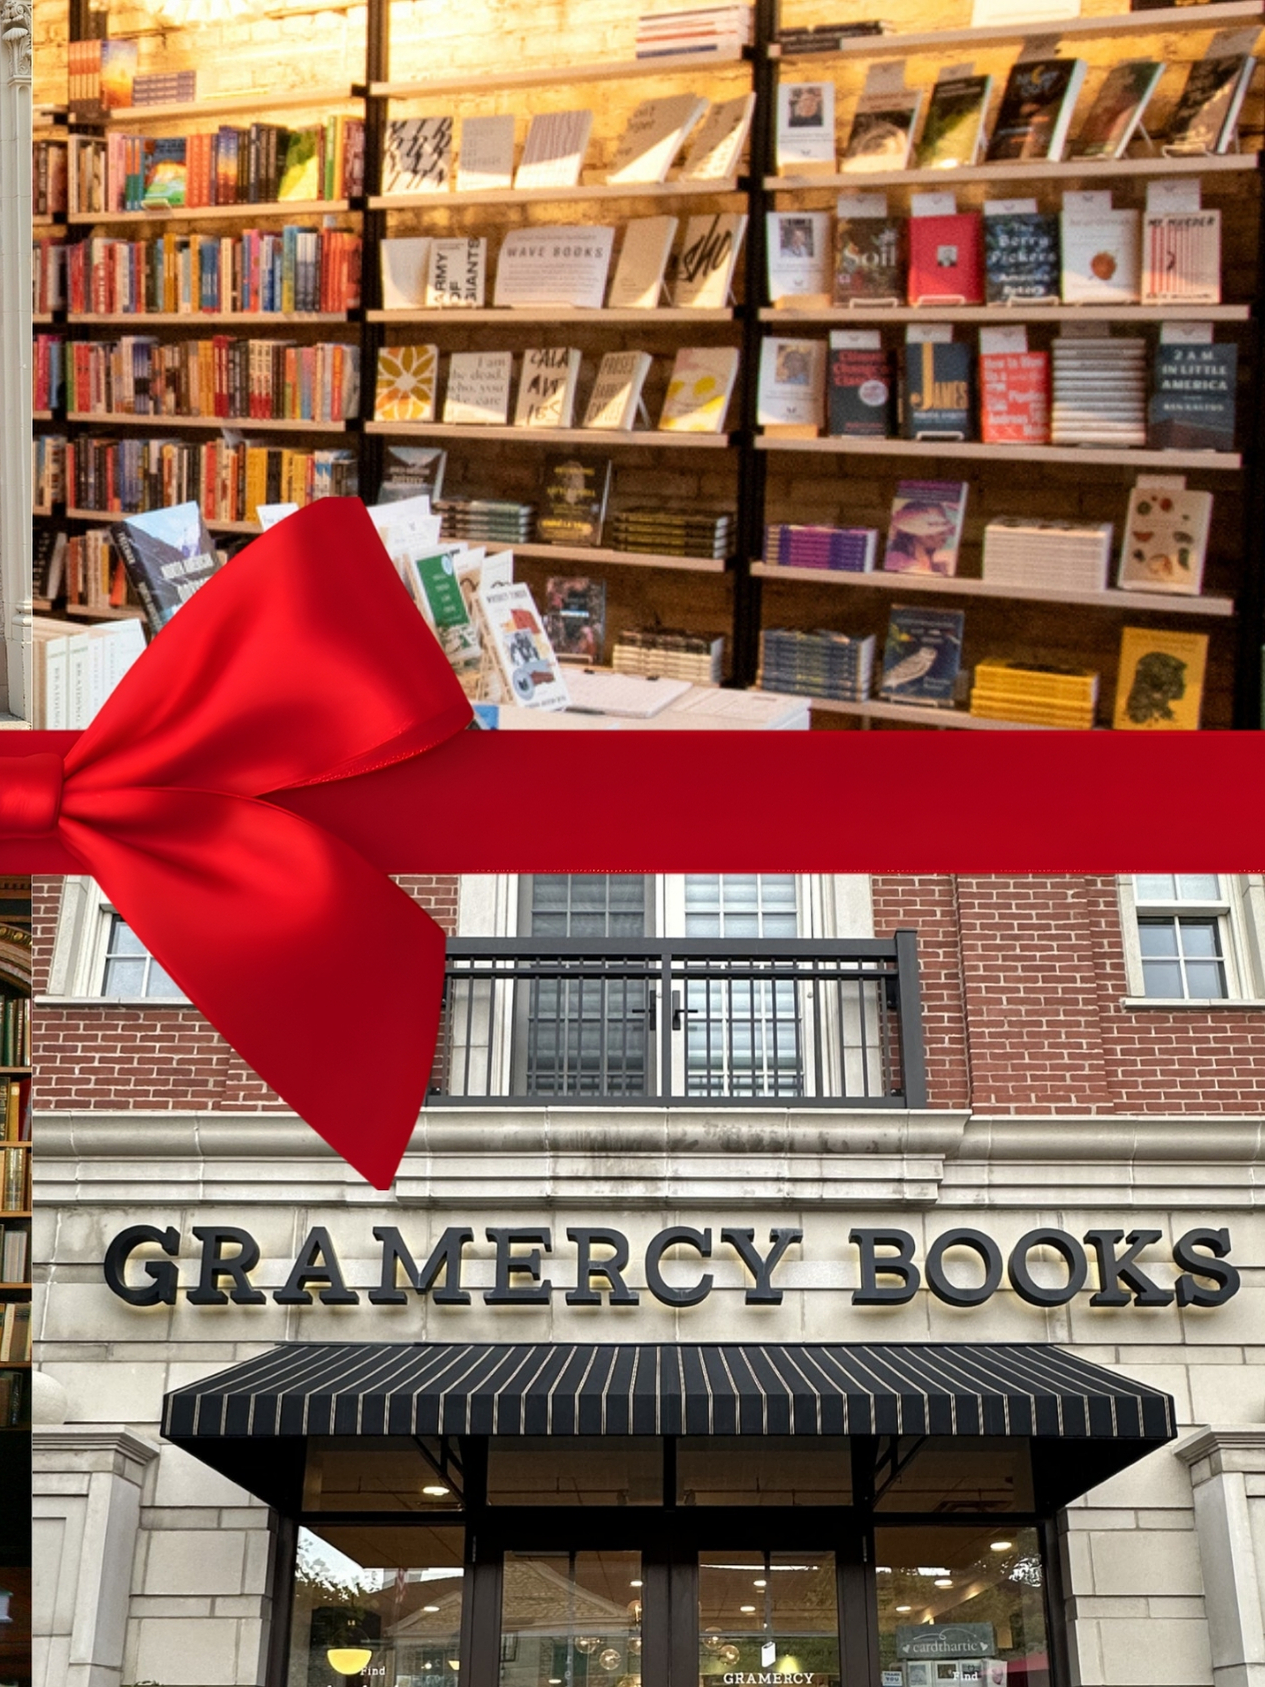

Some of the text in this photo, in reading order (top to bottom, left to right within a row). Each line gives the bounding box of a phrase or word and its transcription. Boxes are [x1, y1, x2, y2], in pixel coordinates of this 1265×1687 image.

[999, 235, 1050, 249] Berry
[507, 246, 604, 258] WAVE BOOKS
[844, 247, 896, 267] Soil
[991, 250, 1057, 264] Pickers
[1174, 349, 1183, 361] 2
[1162, 365, 1227, 375] IN LITTLE
[910, 342, 969, 411] JAMES
[1162, 380, 1228, 391] AMERICA
[104, 1224, 1241, 1308] GRAMERCY BOOKS
[913, 1641, 978, 1653] cardthartic
[360, 1665, 386, 1676] Find
[952, 1671, 979, 1681] Find
[723, 1672, 814, 1684] GRAMERCY
